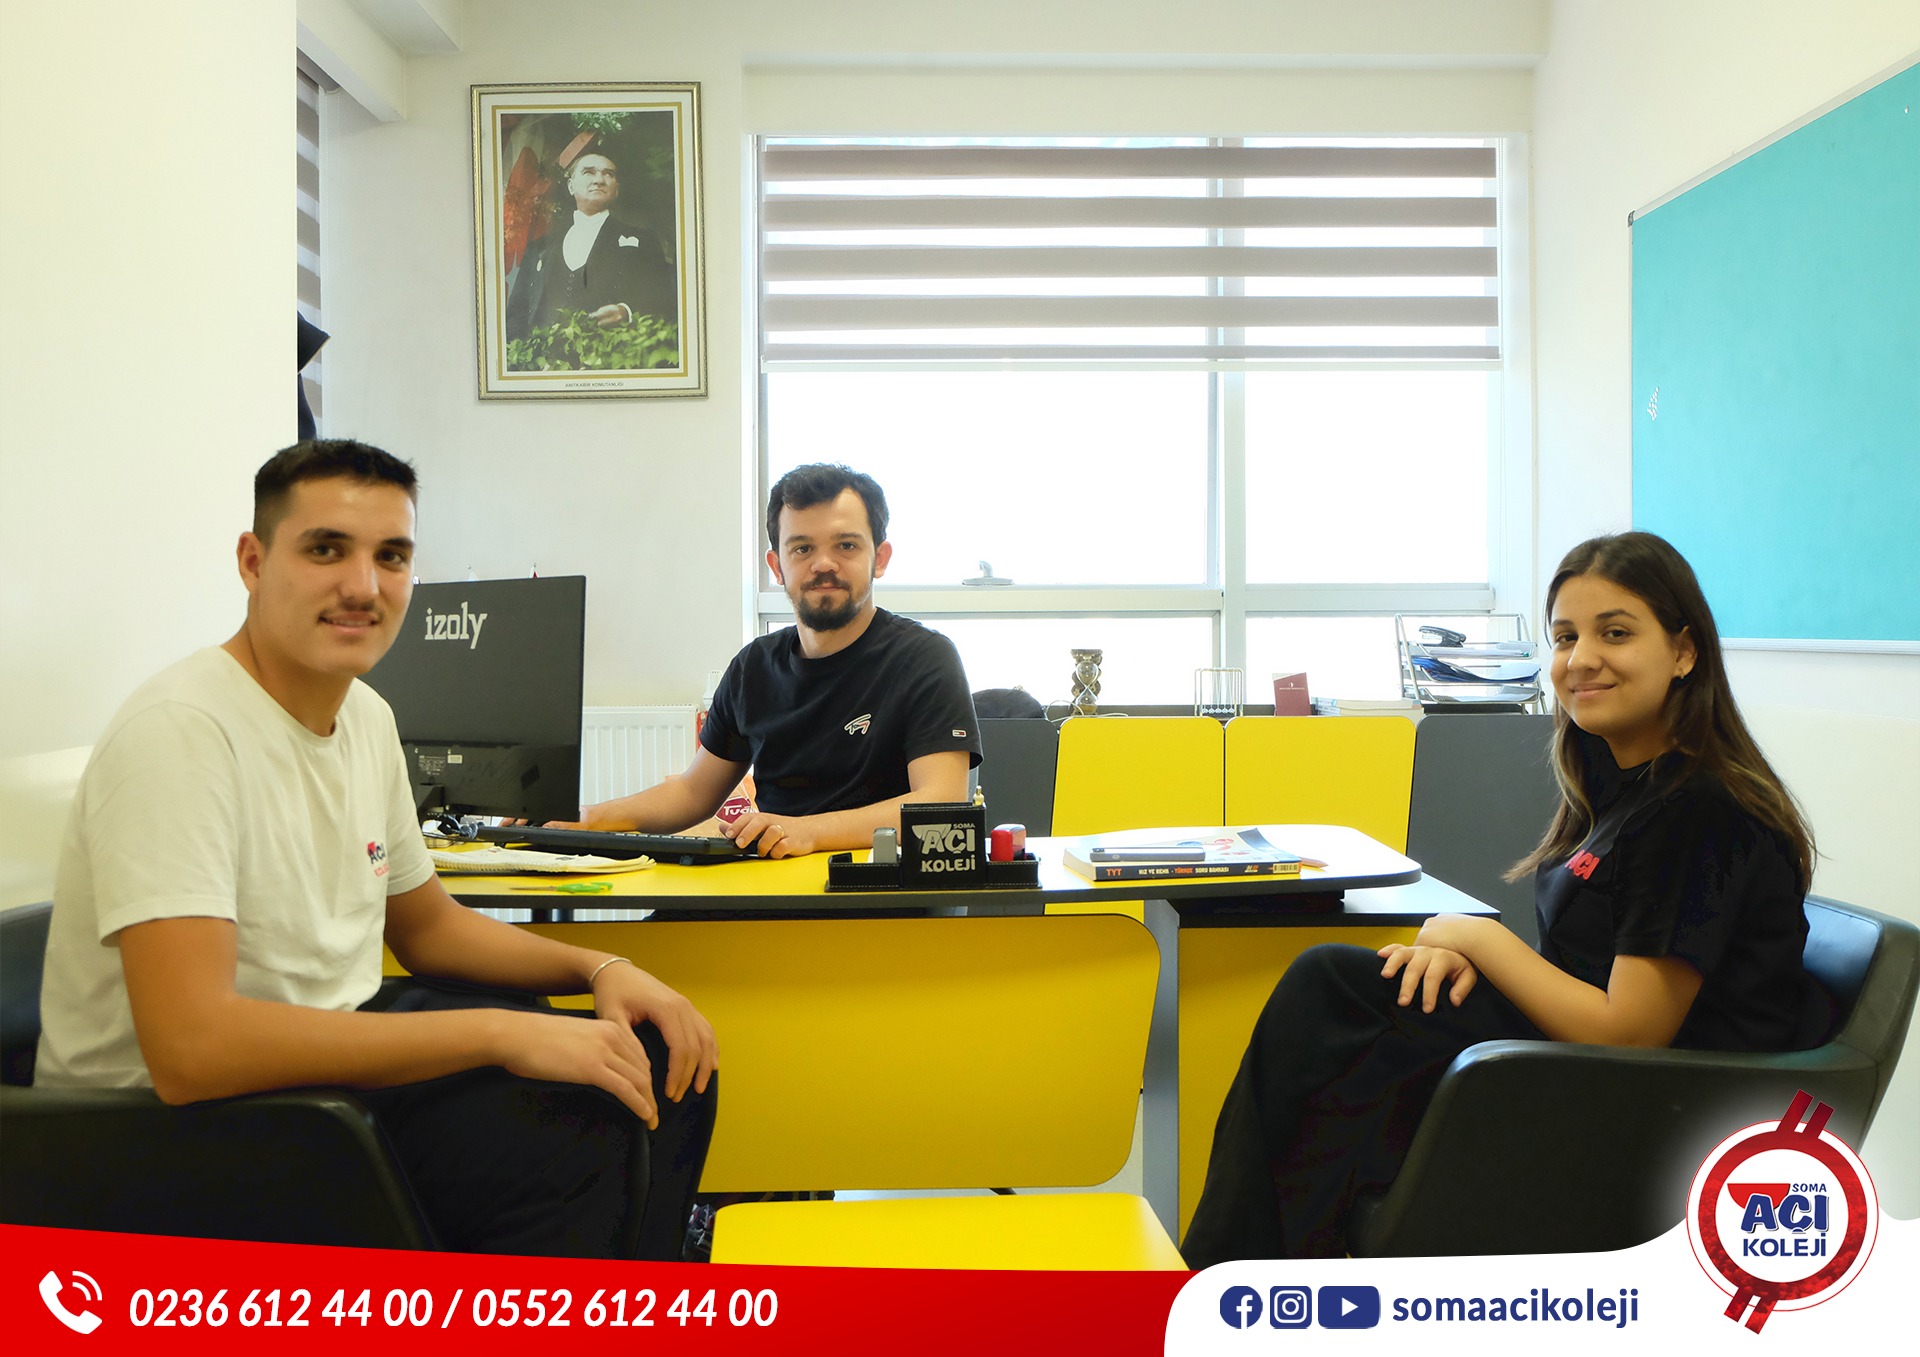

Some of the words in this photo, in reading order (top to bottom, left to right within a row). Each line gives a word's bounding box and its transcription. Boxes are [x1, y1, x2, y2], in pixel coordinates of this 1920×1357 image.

[424, 601, 488, 650] izoly
[921, 828, 976, 855] AÇI
[921, 854, 976, 873] KOLEJİ
[1106, 868, 1122, 876] TYT
